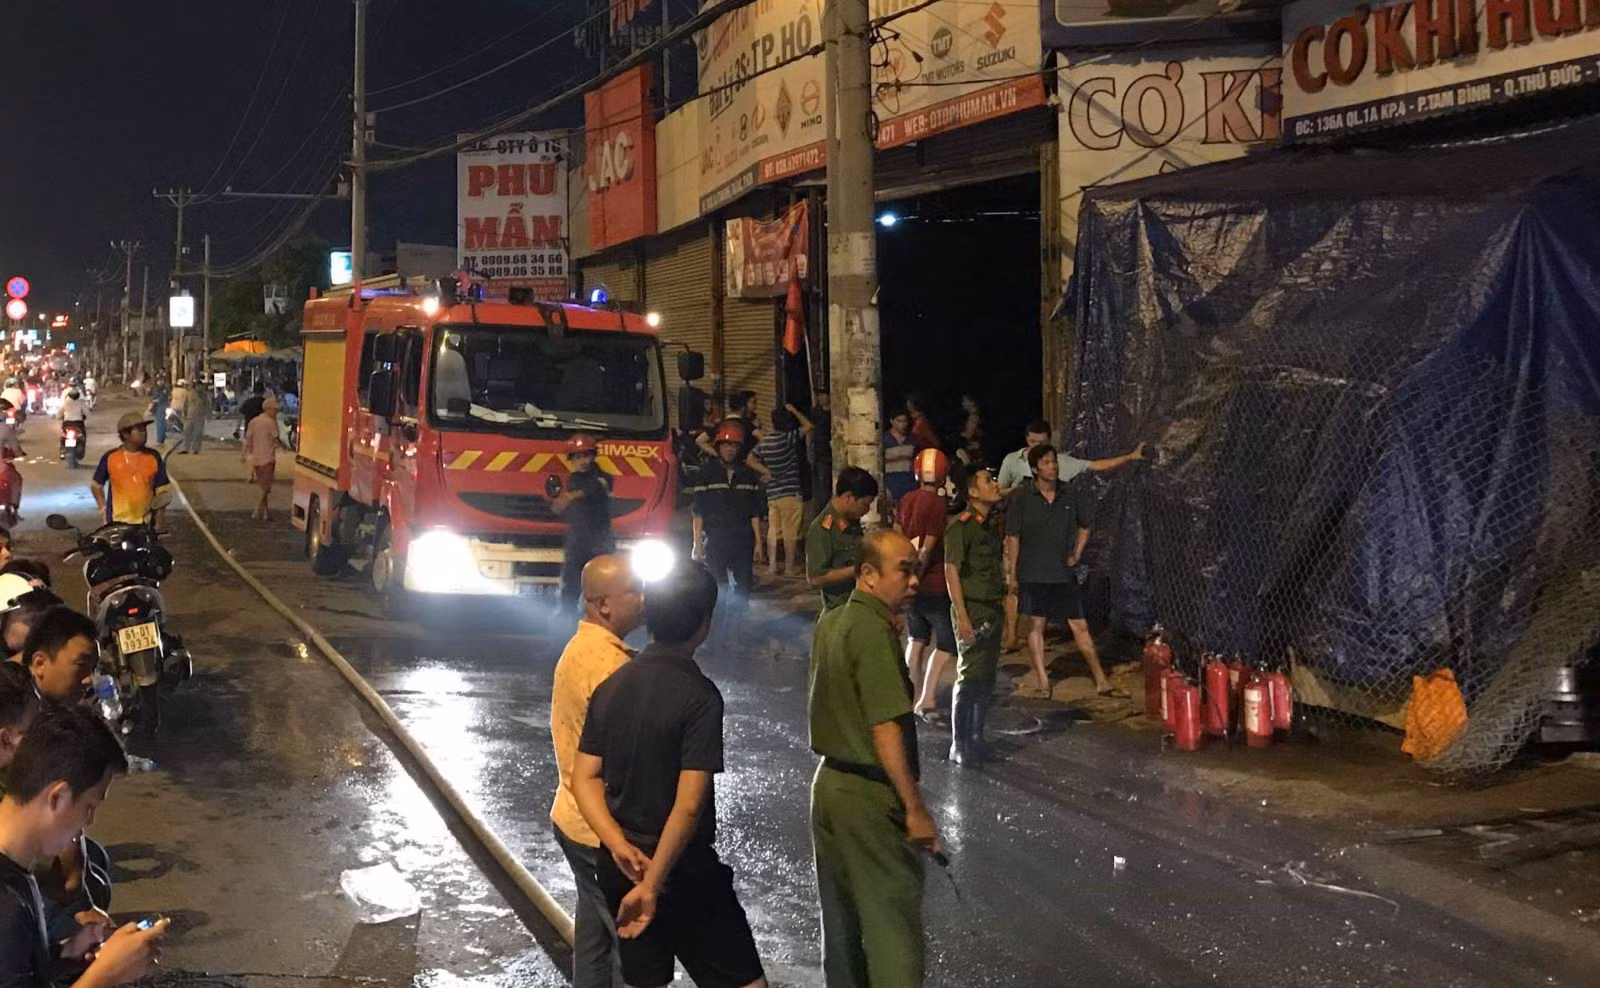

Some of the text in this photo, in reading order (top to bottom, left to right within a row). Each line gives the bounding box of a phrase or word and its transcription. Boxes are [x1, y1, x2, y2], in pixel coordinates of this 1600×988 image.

[936, 61, 965, 80] MOTORS
[976, 46, 1016, 71] SUZUKI
[1292, 2, 1370, 93] CƠ
[801, 114, 823, 130] HINO
[904, 117, 928, 137] WEB:
[930, 87, 1017, 130] OTOPHUMAN.VN
[1068, 60, 1185, 150] CƠ
[1296, 119, 1315, 136] ĐC:
[1316, 115, 1344, 132] 136A
[1346, 108, 1378, 127] QL.1A
[1417, 90, 1454, 113] P.TAM
[1457, 84, 1492, 105] BÌNH
[1504, 67, 1546, 96] Q.THỦ
[1550, 64, 1582, 87] ĐỨC
[588, 131, 634, 193] JAC
[463, 202, 562, 250] MẪN
